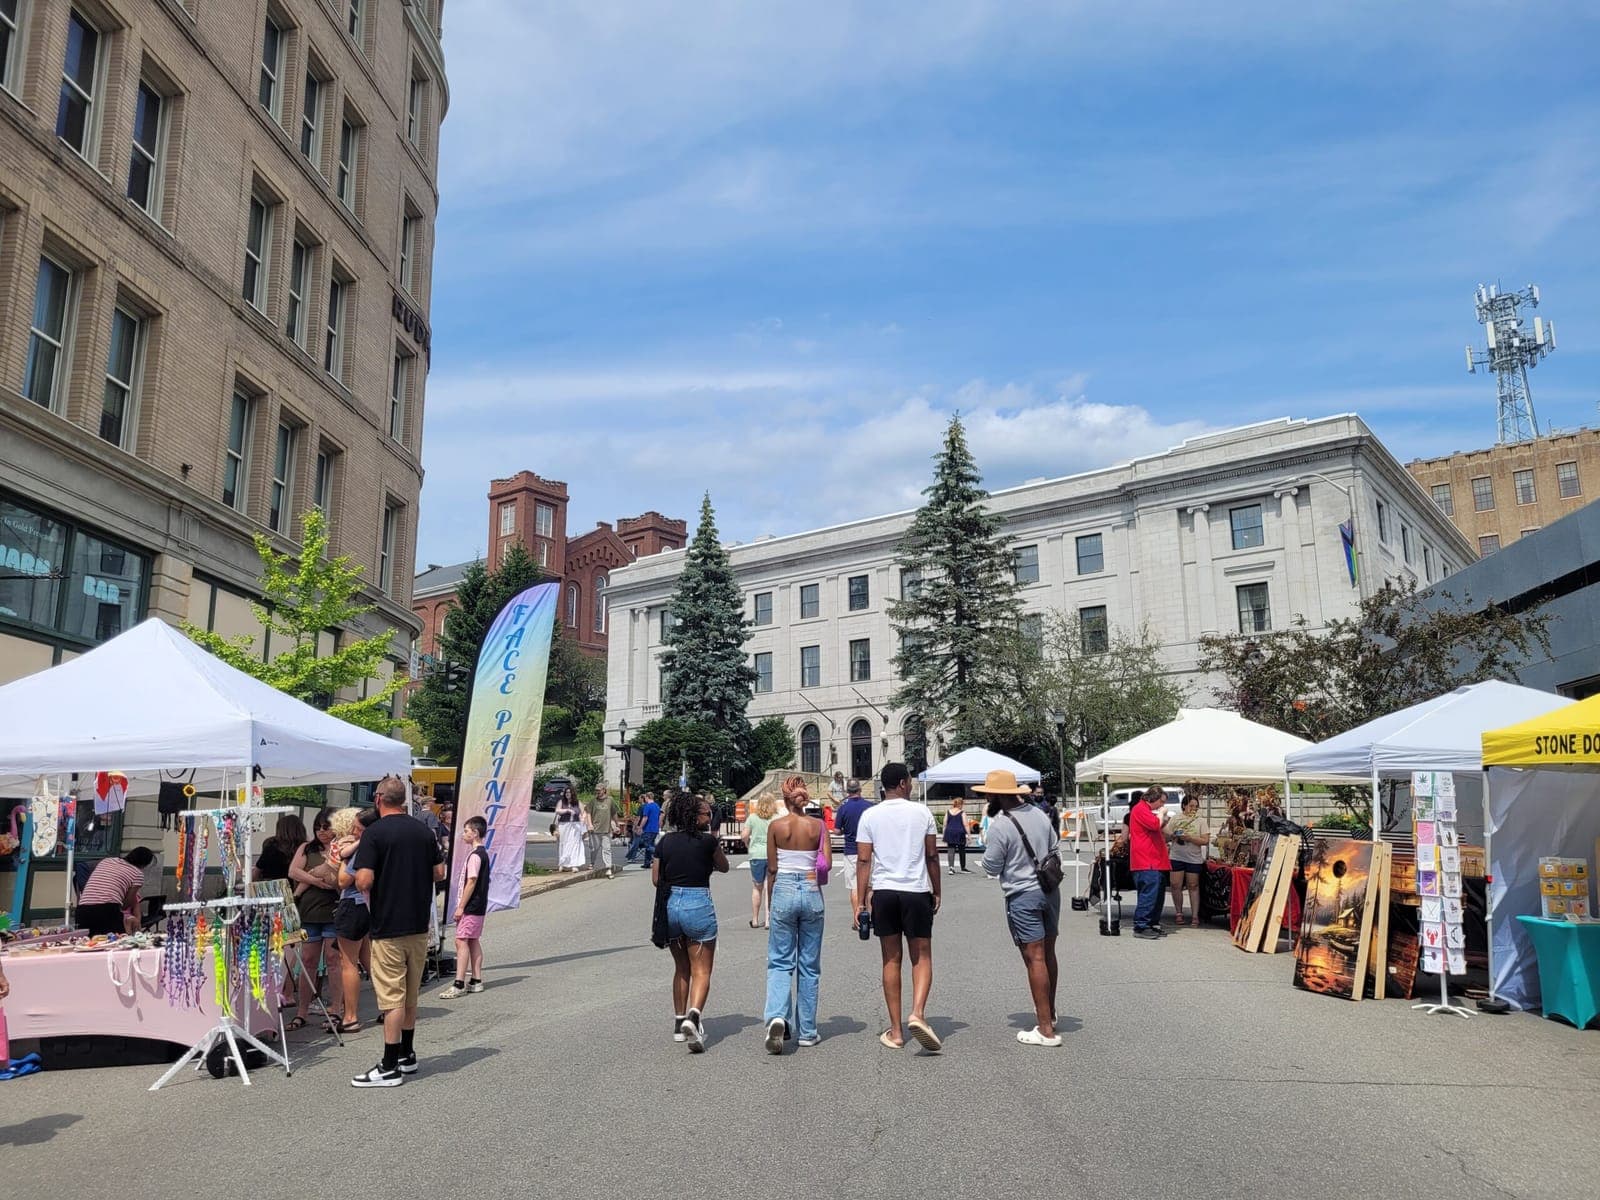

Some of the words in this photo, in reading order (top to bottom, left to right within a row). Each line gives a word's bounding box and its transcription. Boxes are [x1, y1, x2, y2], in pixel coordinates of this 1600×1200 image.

[83, 575, 119, 604] BAR
[500, 604, 529, 694] FACE
[1535, 734, 1577, 755] STONE
